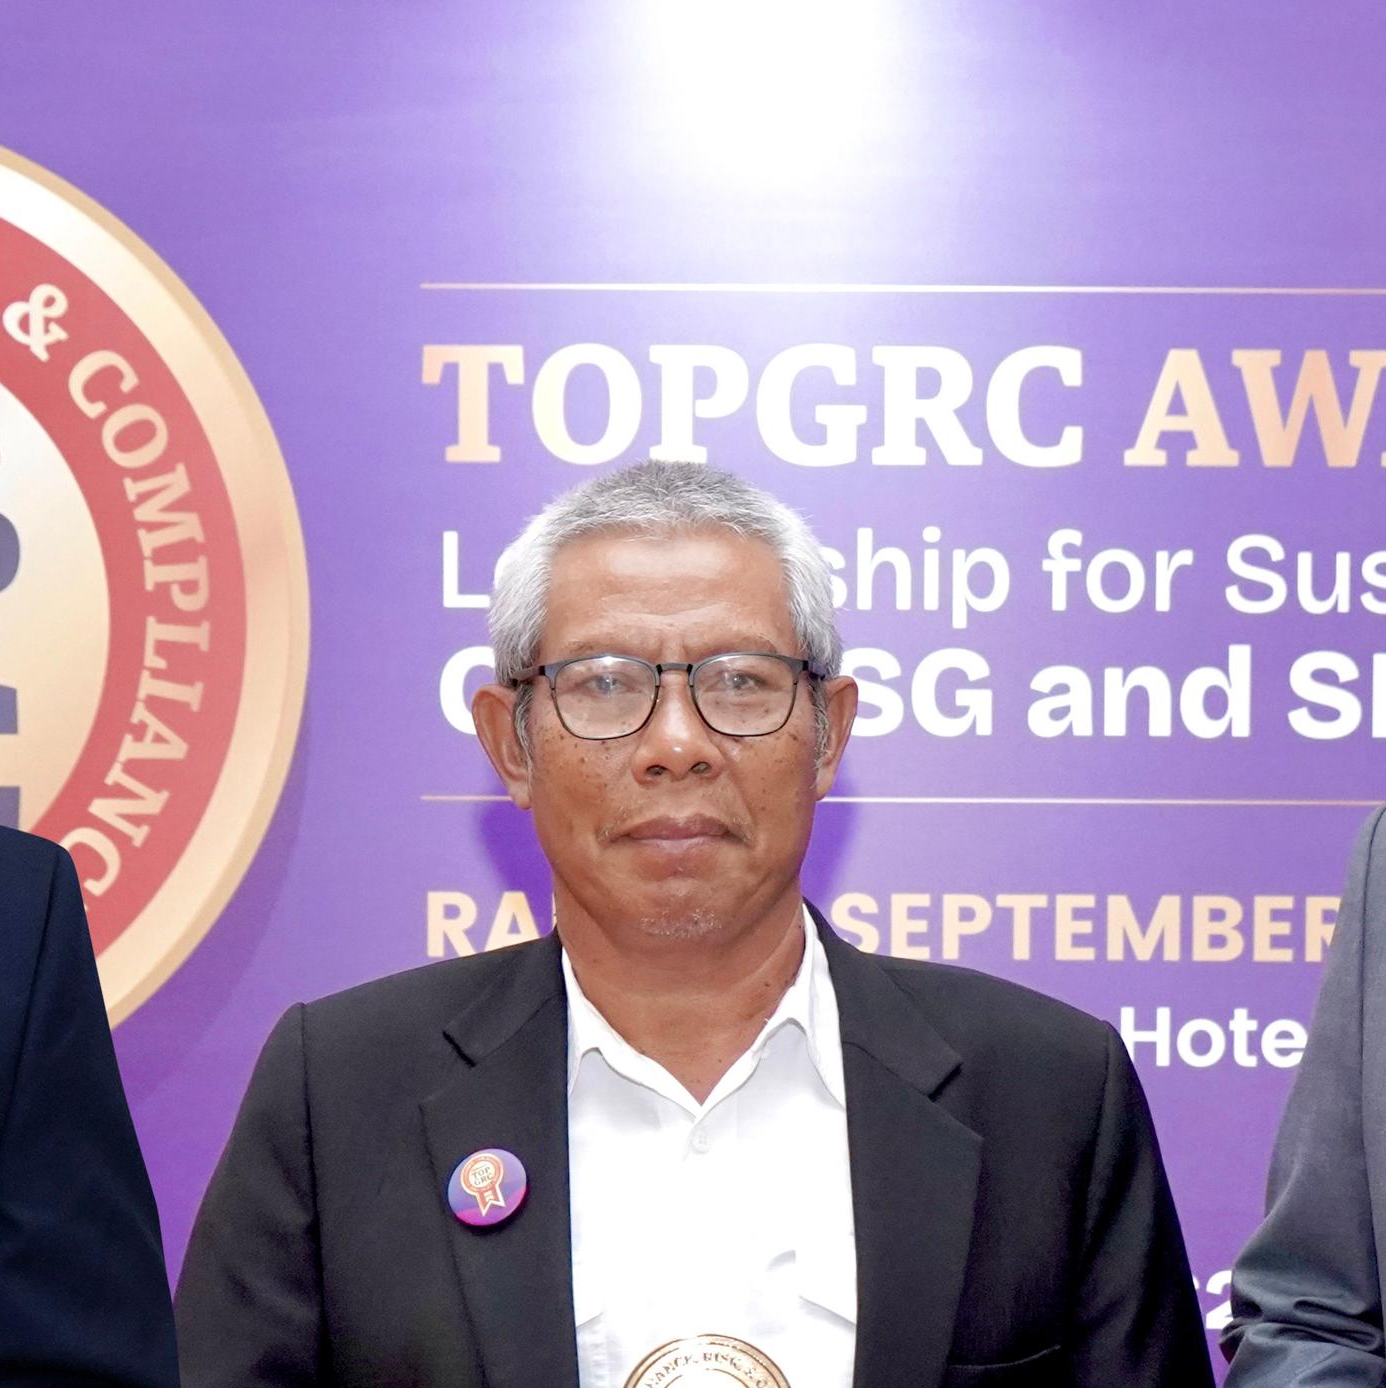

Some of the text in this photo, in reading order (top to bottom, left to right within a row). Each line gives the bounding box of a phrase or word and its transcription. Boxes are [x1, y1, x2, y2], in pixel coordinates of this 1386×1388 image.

[422, 343, 1083, 467] TOPGRC
[2, 283, 69, 362] &
[67, 348, 211, 910] COMPLIANC
[1042, 530, 1193, 613] for
[841, 646, 994, 737] SG
[1026, 643, 1251, 737] and
[831, 892, 1341, 962] SEPTEMBER
[1120, 1006, 1308, 1068] Hote
